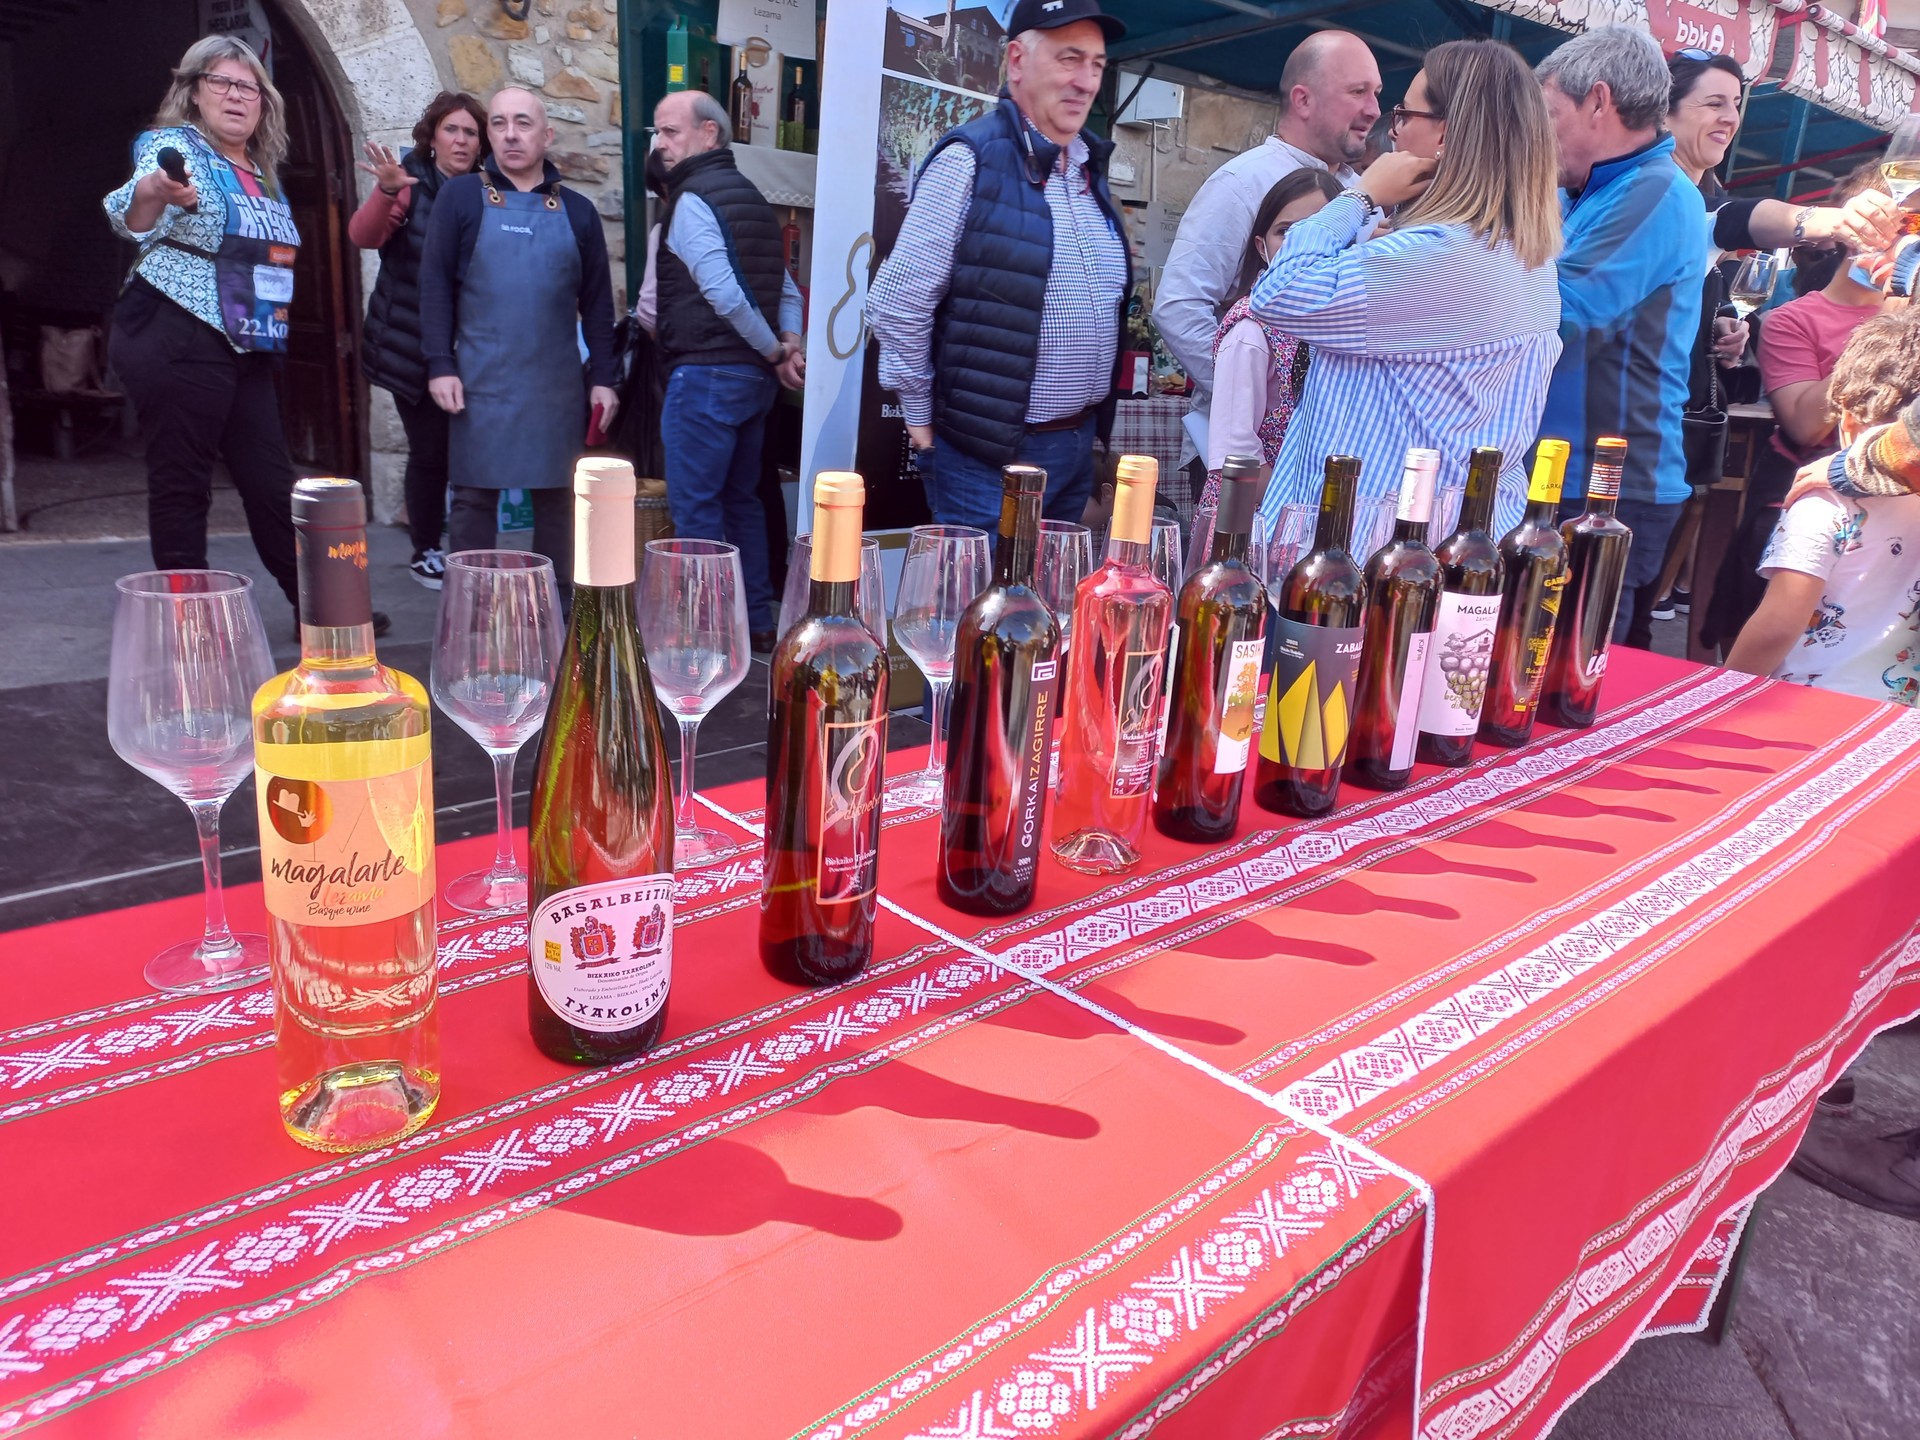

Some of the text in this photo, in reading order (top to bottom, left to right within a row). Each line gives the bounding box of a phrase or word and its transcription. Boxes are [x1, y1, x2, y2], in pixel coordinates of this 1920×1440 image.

[754, 7, 782, 20] Lezama
[1021, 691, 1048, 848] GORKAIZAGIRRE
[271, 849, 408, 900] magalarte
[307, 901, 371, 920] Basque wine
[587, 971, 620, 979] BIZKAIKO
[622, 960, 655, 976] TXAKOLINA
[565, 977, 667, 1019] TXAKOLINA
[617, 989, 638, 998] BIZKAIA
